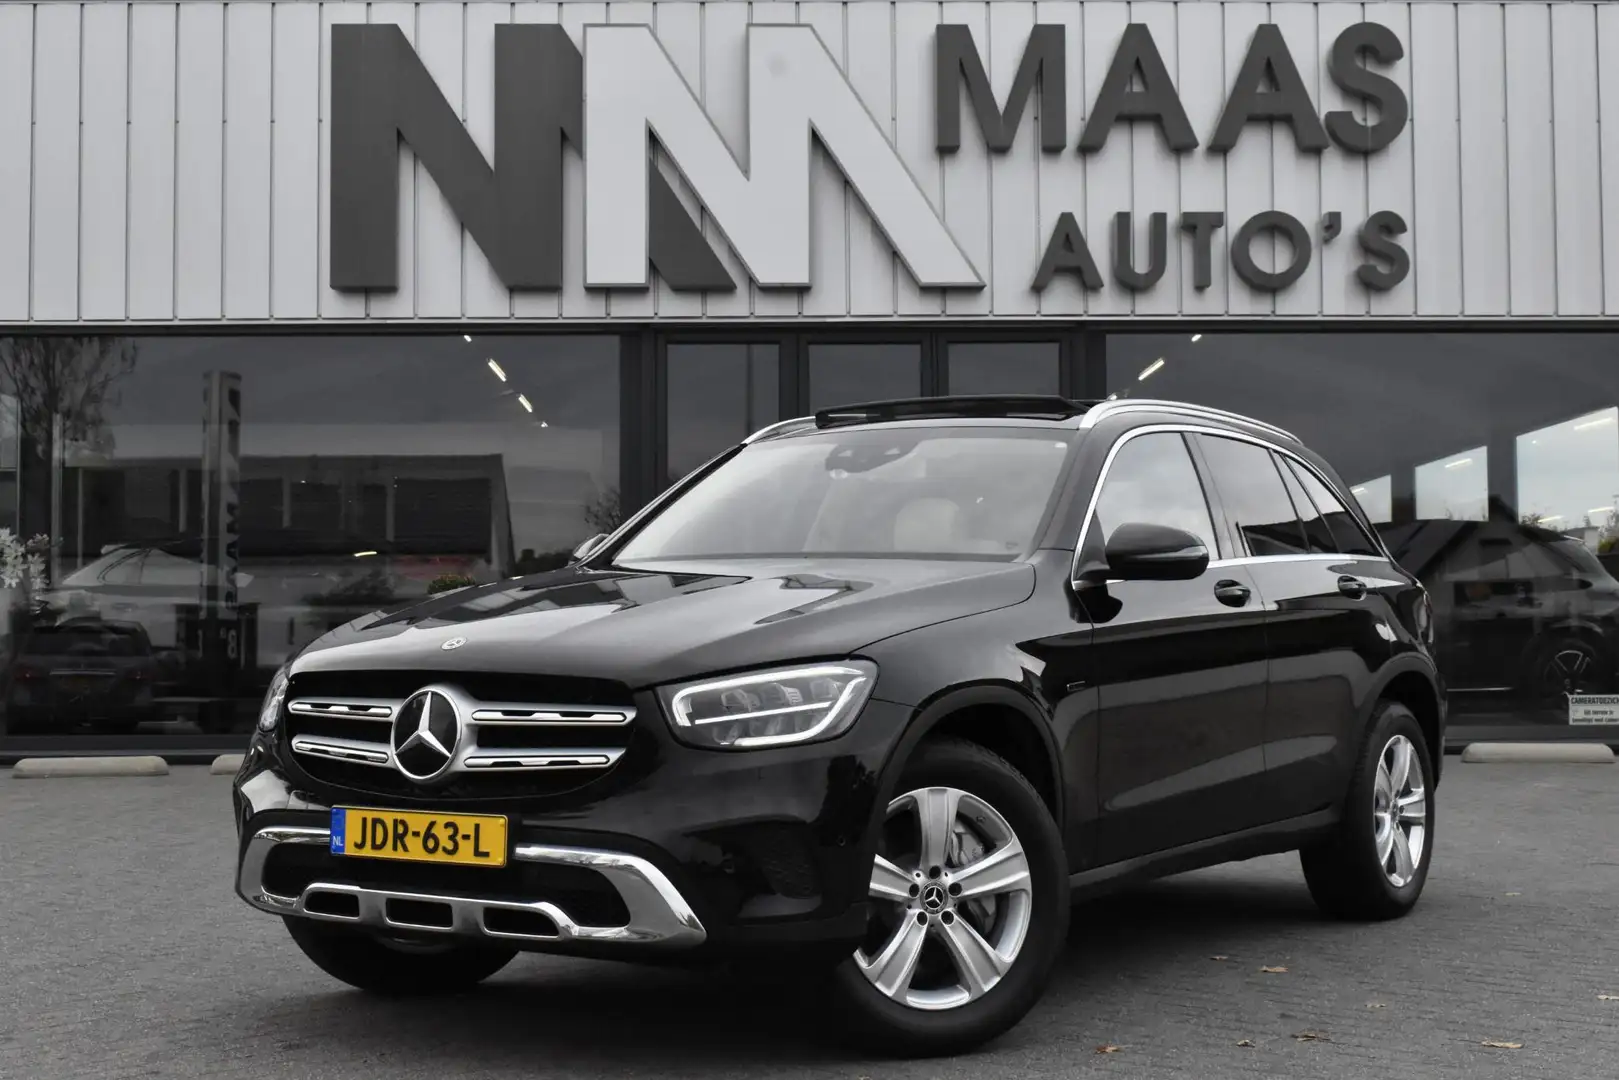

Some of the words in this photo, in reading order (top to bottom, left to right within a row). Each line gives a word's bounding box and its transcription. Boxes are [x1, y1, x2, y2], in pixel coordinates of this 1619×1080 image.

[935, 21, 1409, 153] MAAS
[1030, 210, 1411, 293] AUTO'S
[332, 835, 343, 847] NL
[354, 816, 490, 858] JDR-63-L
